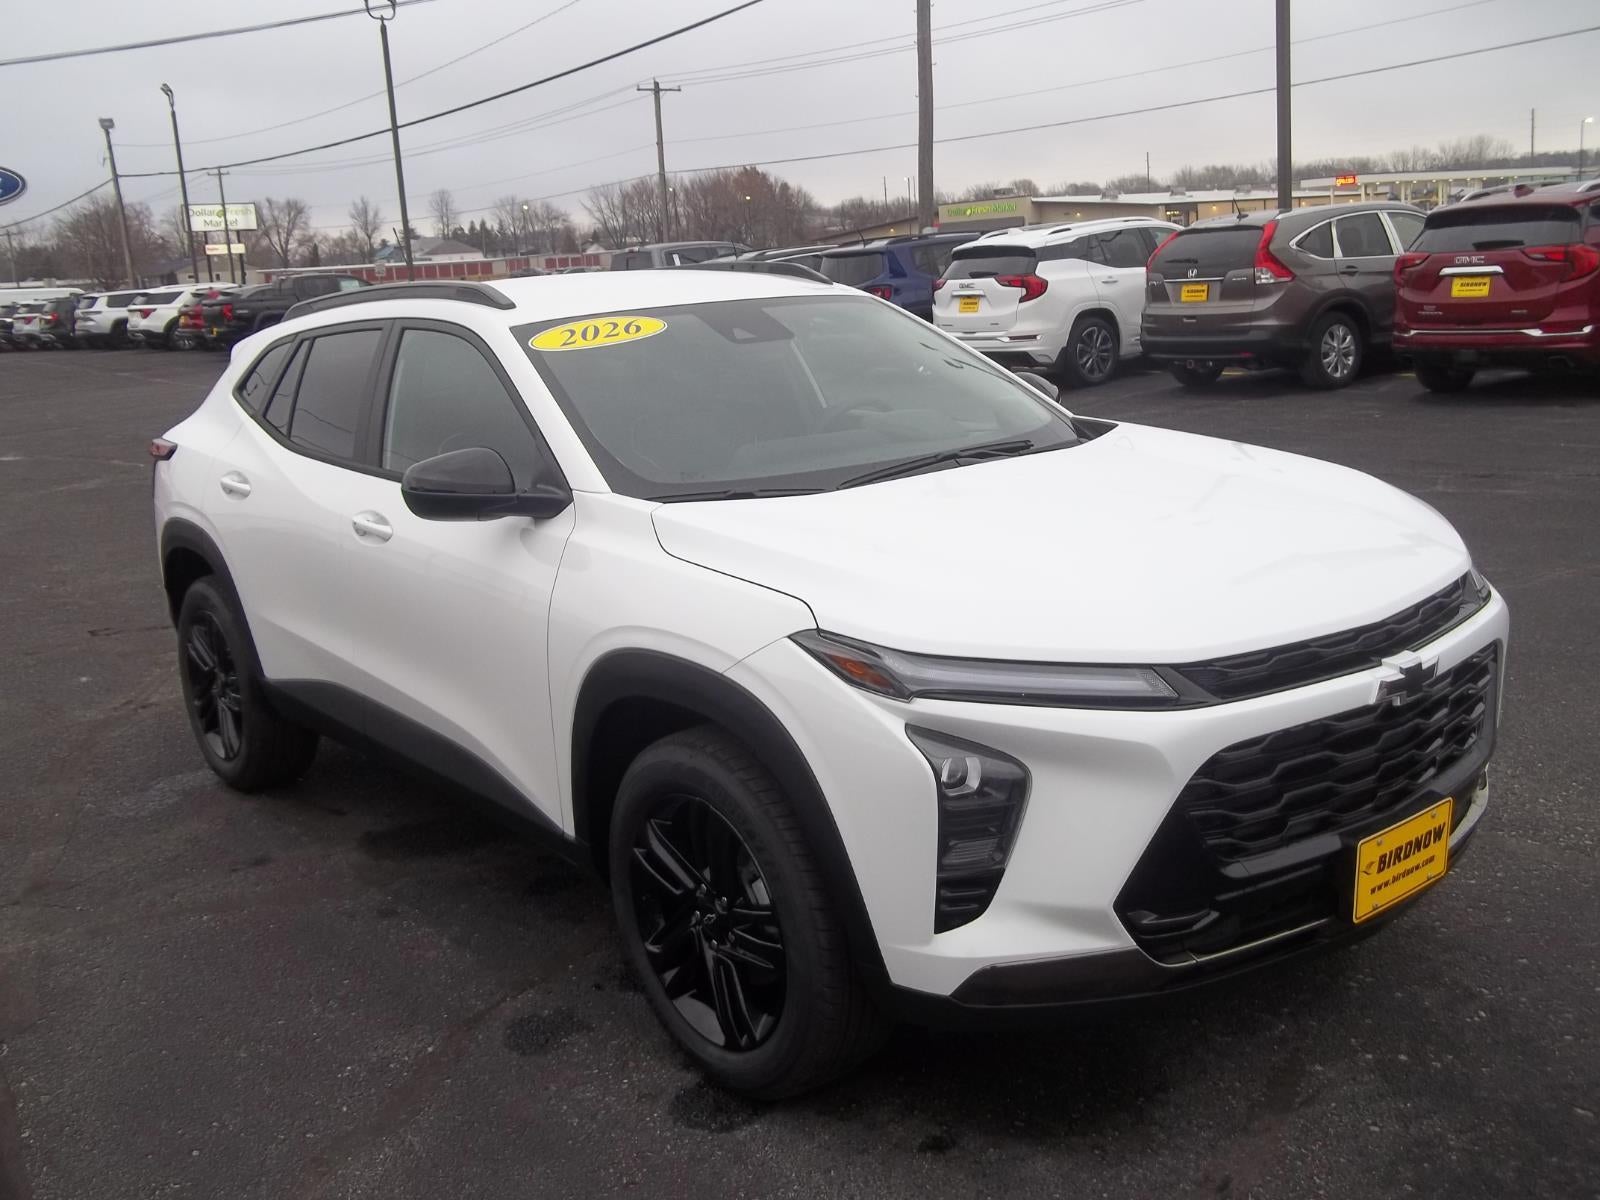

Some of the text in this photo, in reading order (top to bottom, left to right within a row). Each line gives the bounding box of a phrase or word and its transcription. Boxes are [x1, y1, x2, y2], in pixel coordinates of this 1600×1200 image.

[203, 218, 238, 228] Maret
[1455, 255, 1485, 264] GMC
[559, 319, 642, 347] 2026
[1376, 822, 1446, 874] BIRDNOW
[1369, 855, 1436, 895] www.birdnow.com
